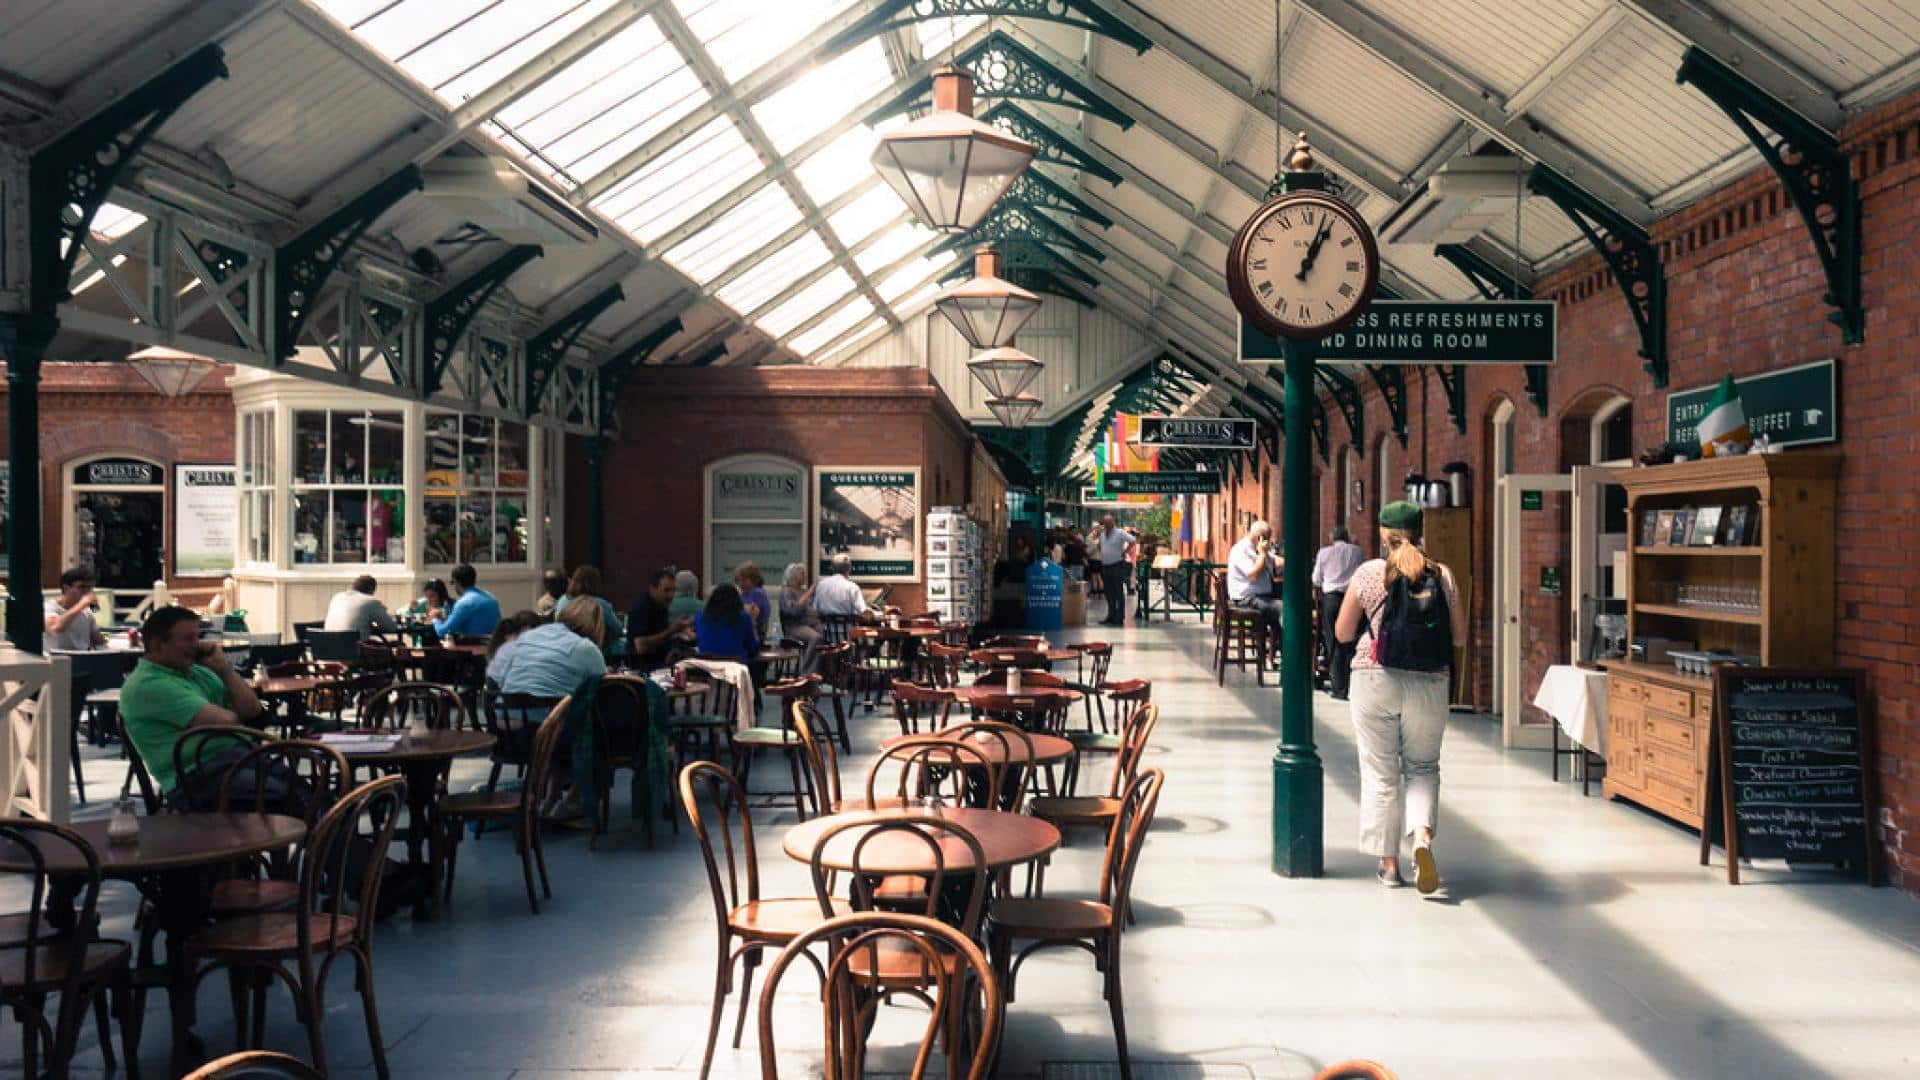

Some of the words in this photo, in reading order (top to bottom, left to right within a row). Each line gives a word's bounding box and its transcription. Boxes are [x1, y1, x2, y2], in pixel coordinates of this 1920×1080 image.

[1389, 312, 1545, 328] REFRESHMENTS
[1320, 334, 1346, 349] ND
[1356, 333, 1423, 349] DINING
[1433, 333, 1489, 349] ROOM
[1748, 411, 1793, 432] BUFFET
[829, 474, 905, 483] QUEENSTOWN
